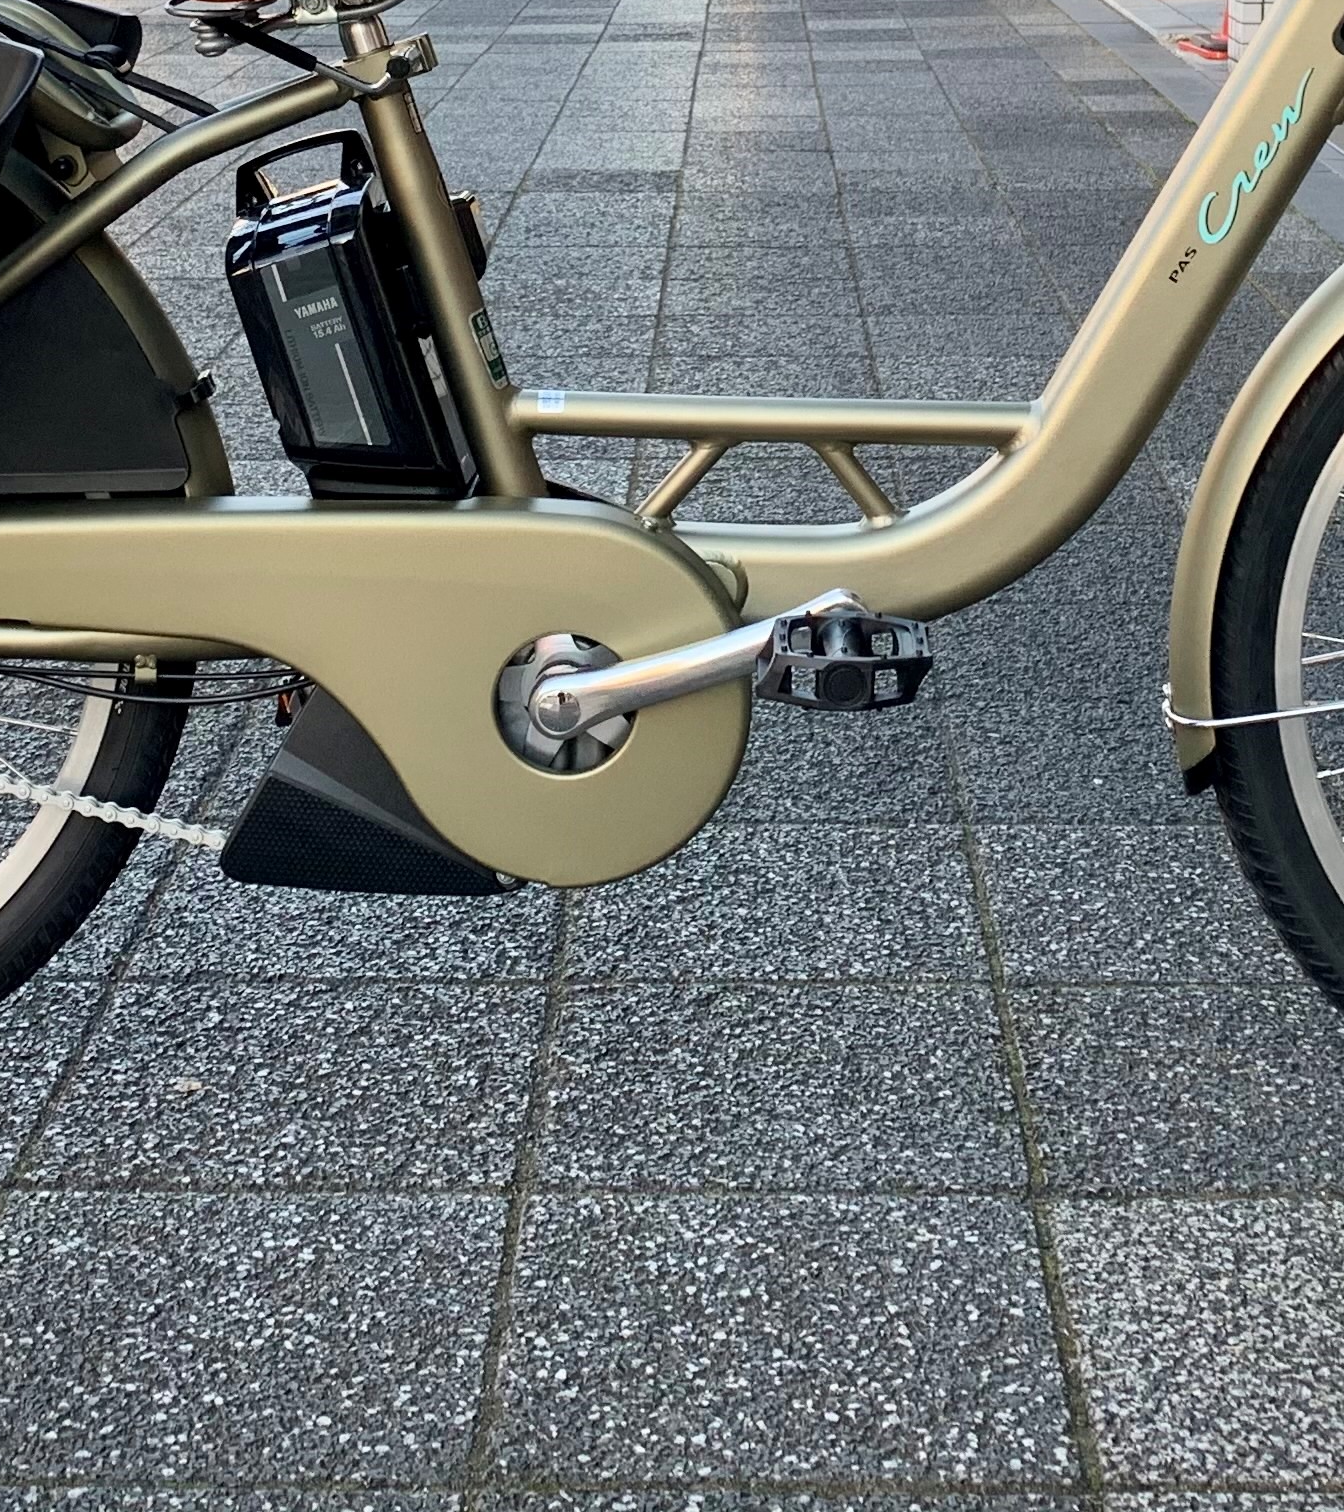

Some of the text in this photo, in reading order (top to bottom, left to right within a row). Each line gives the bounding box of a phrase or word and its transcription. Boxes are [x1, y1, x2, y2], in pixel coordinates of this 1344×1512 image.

[1168, 67, 1314, 283] PAS Crew
[293, 296, 339, 319] YAMAHA
[332, 323, 347, 335] Ah
